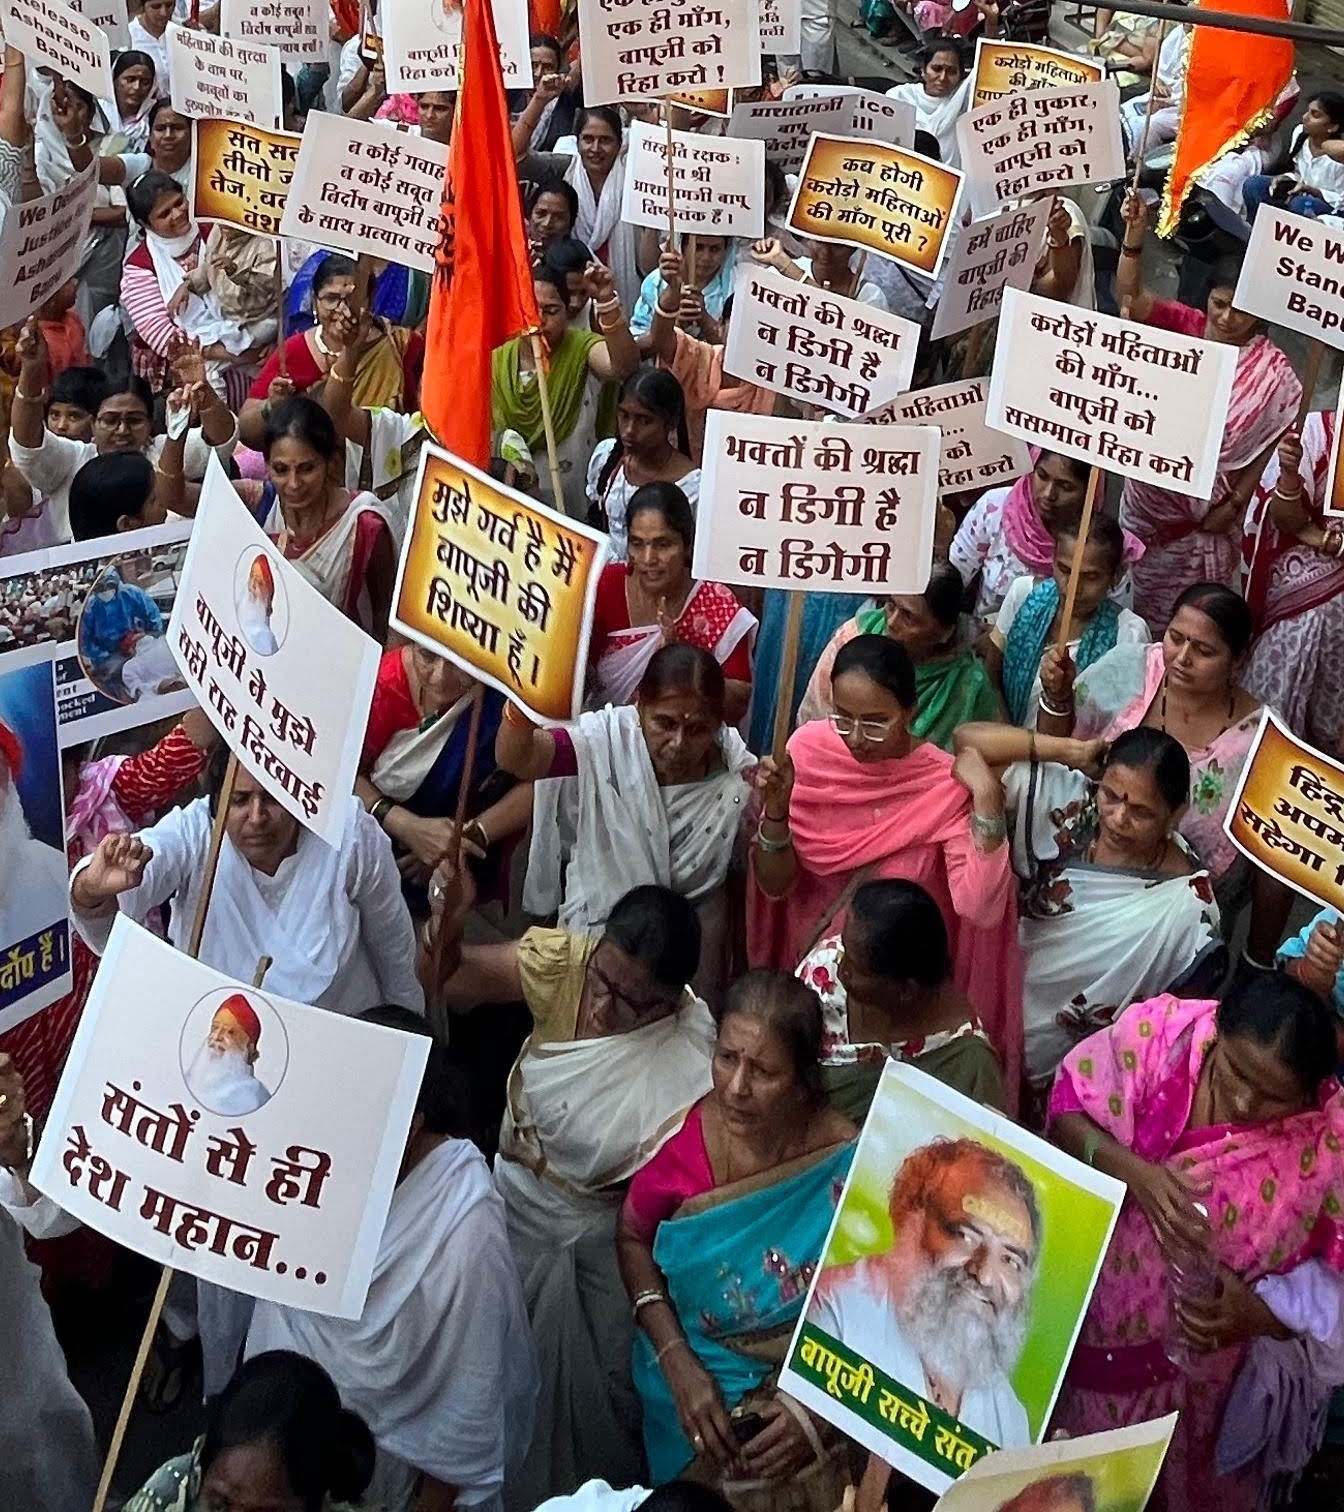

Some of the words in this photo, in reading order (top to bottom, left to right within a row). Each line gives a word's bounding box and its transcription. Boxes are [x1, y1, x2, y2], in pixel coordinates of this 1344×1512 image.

[9, 6, 103, 67] Asharamji
[35, 36, 82, 74] Bapu
[618, 37, 685, 66] बापूजी
[692, 33, 722, 56] को
[617, 70, 660, 96] रिहा
[666, 63, 707, 87] करो
[228, 126, 261, 154] संत
[1272, 220, 1315, 253] We
[959, 250, 1004, 285] बापूजी
[1006, 240, 1029, 265] की
[1048, 387, 1119, 425] बापूजी
[1123, 408, 1157, 437] को
[726, 430, 810, 472] भक्तों
[814, 436, 855, 474] की
[861, 444, 922, 476] श्रद्धा
[1004, 405, 1093, 453] ससम्मान
[1096, 434, 1144, 468] रिहा
[1148, 454, 1194, 485] करो
[738, 490, 768, 520] न
[779, 482, 867, 525] डिगी
[873, 484, 900, 531] है
[433, 478, 473, 525] मुझे
[476, 504, 521, 555] गर्व
[523, 510, 545, 572] है
[552, 530, 584, 588] मैं
[436, 534, 510, 605] बापूजी
[518, 580, 552, 633] की
[738, 544, 768, 576] न
[778, 538, 892, 583] डिगेगी
[195, 591, 249, 685] बापूजी
[249, 668, 269, 709] ने
[272, 696, 319, 759] मुझे
[100, 1079, 203, 1164] संतों
[205, 1126, 257, 1187] से
[264, 1144, 333, 1210] ही
[63, 1125, 131, 1213] देश
[139, 1183, 328, 1286] महान...
[797, 1336, 876, 1406] बापूजी
[878, 1387, 930, 1442] सच्चे
[934, 1421, 978, 1475] संत
